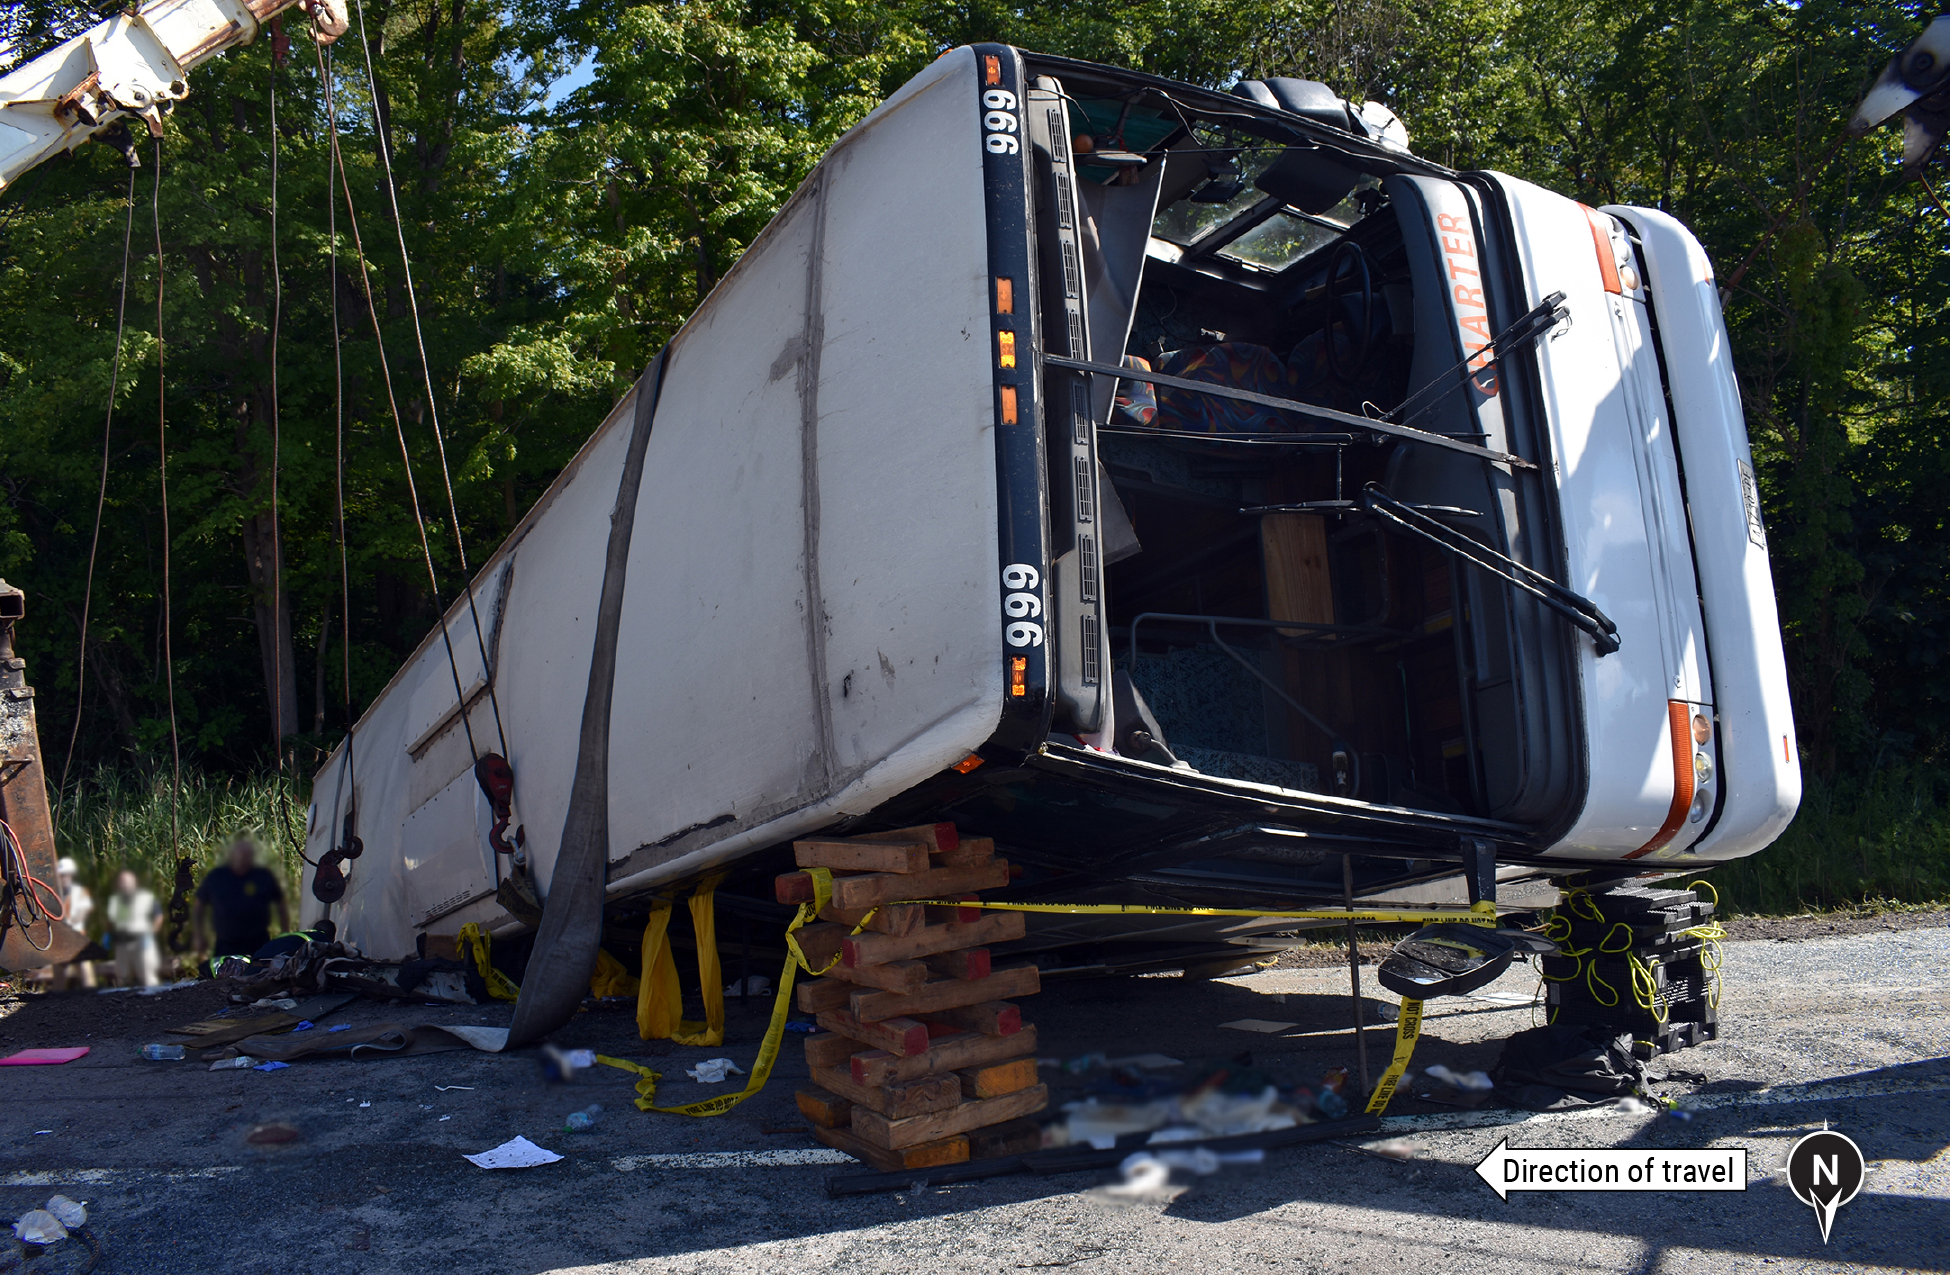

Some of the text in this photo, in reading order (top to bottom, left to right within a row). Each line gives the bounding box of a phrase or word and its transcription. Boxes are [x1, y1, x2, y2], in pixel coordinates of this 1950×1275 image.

[983, 90, 1018, 154] 999
[1438, 213, 1498, 396] CHARTER
[1002, 564, 1043, 646] 999
[1403, 1002, 1420, 1039] NOT CROSS
[1377, 1086, 1394, 1100] LINE
[1383, 1074, 1400, 1086] FIRE
[685, 1105, 702, 1115] FIRE
[698, 1101, 716, 1112] LINE
[713, 1099, 724, 1111] DO
[1372, 1100, 1387, 1108] DO
